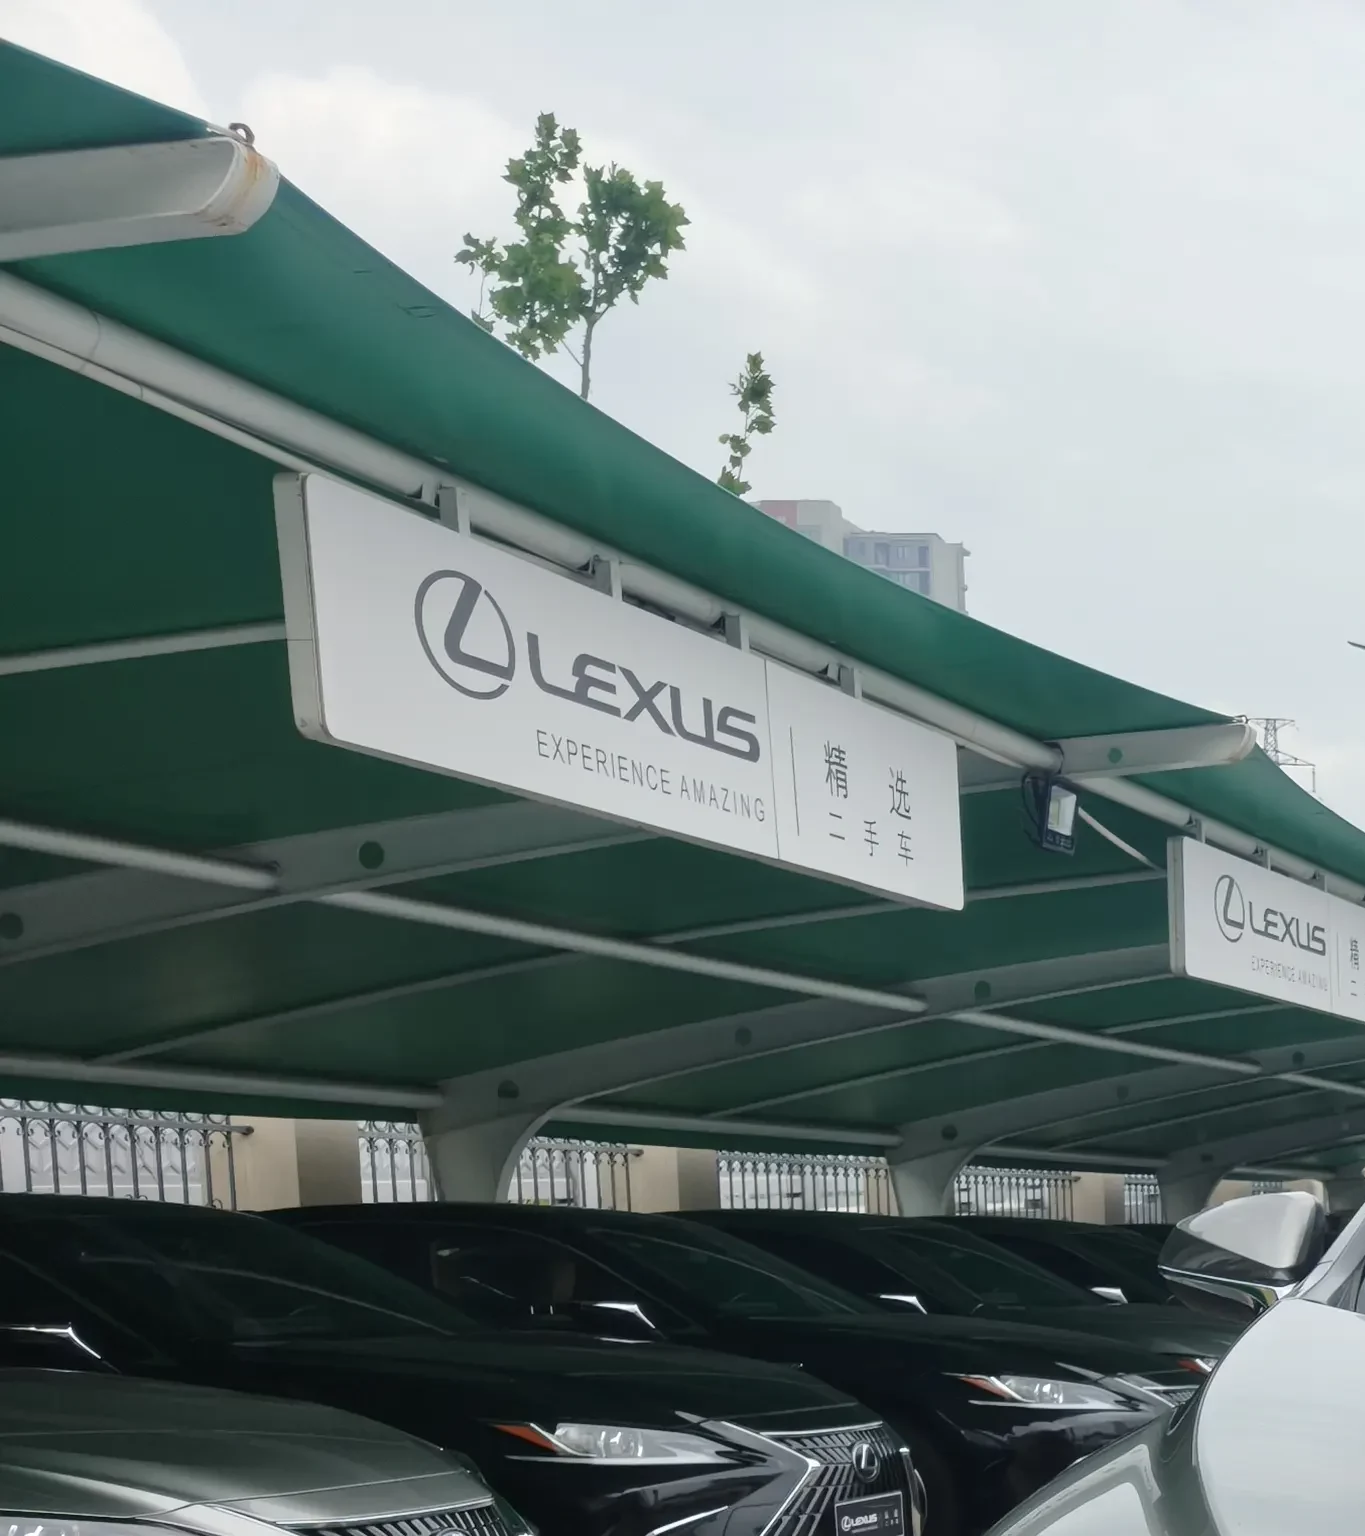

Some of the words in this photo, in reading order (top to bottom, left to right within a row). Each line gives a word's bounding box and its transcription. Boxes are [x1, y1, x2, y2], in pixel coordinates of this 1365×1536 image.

[527, 631, 761, 764] LEXUS
[536, 729, 672, 796] EXPERIENCE
[680, 775, 766, 823] AMAZING
[823, 740, 913, 821] 精选
[828, 811, 915, 866] 二手车
[1248, 900, 1326, 957] LEXUS
